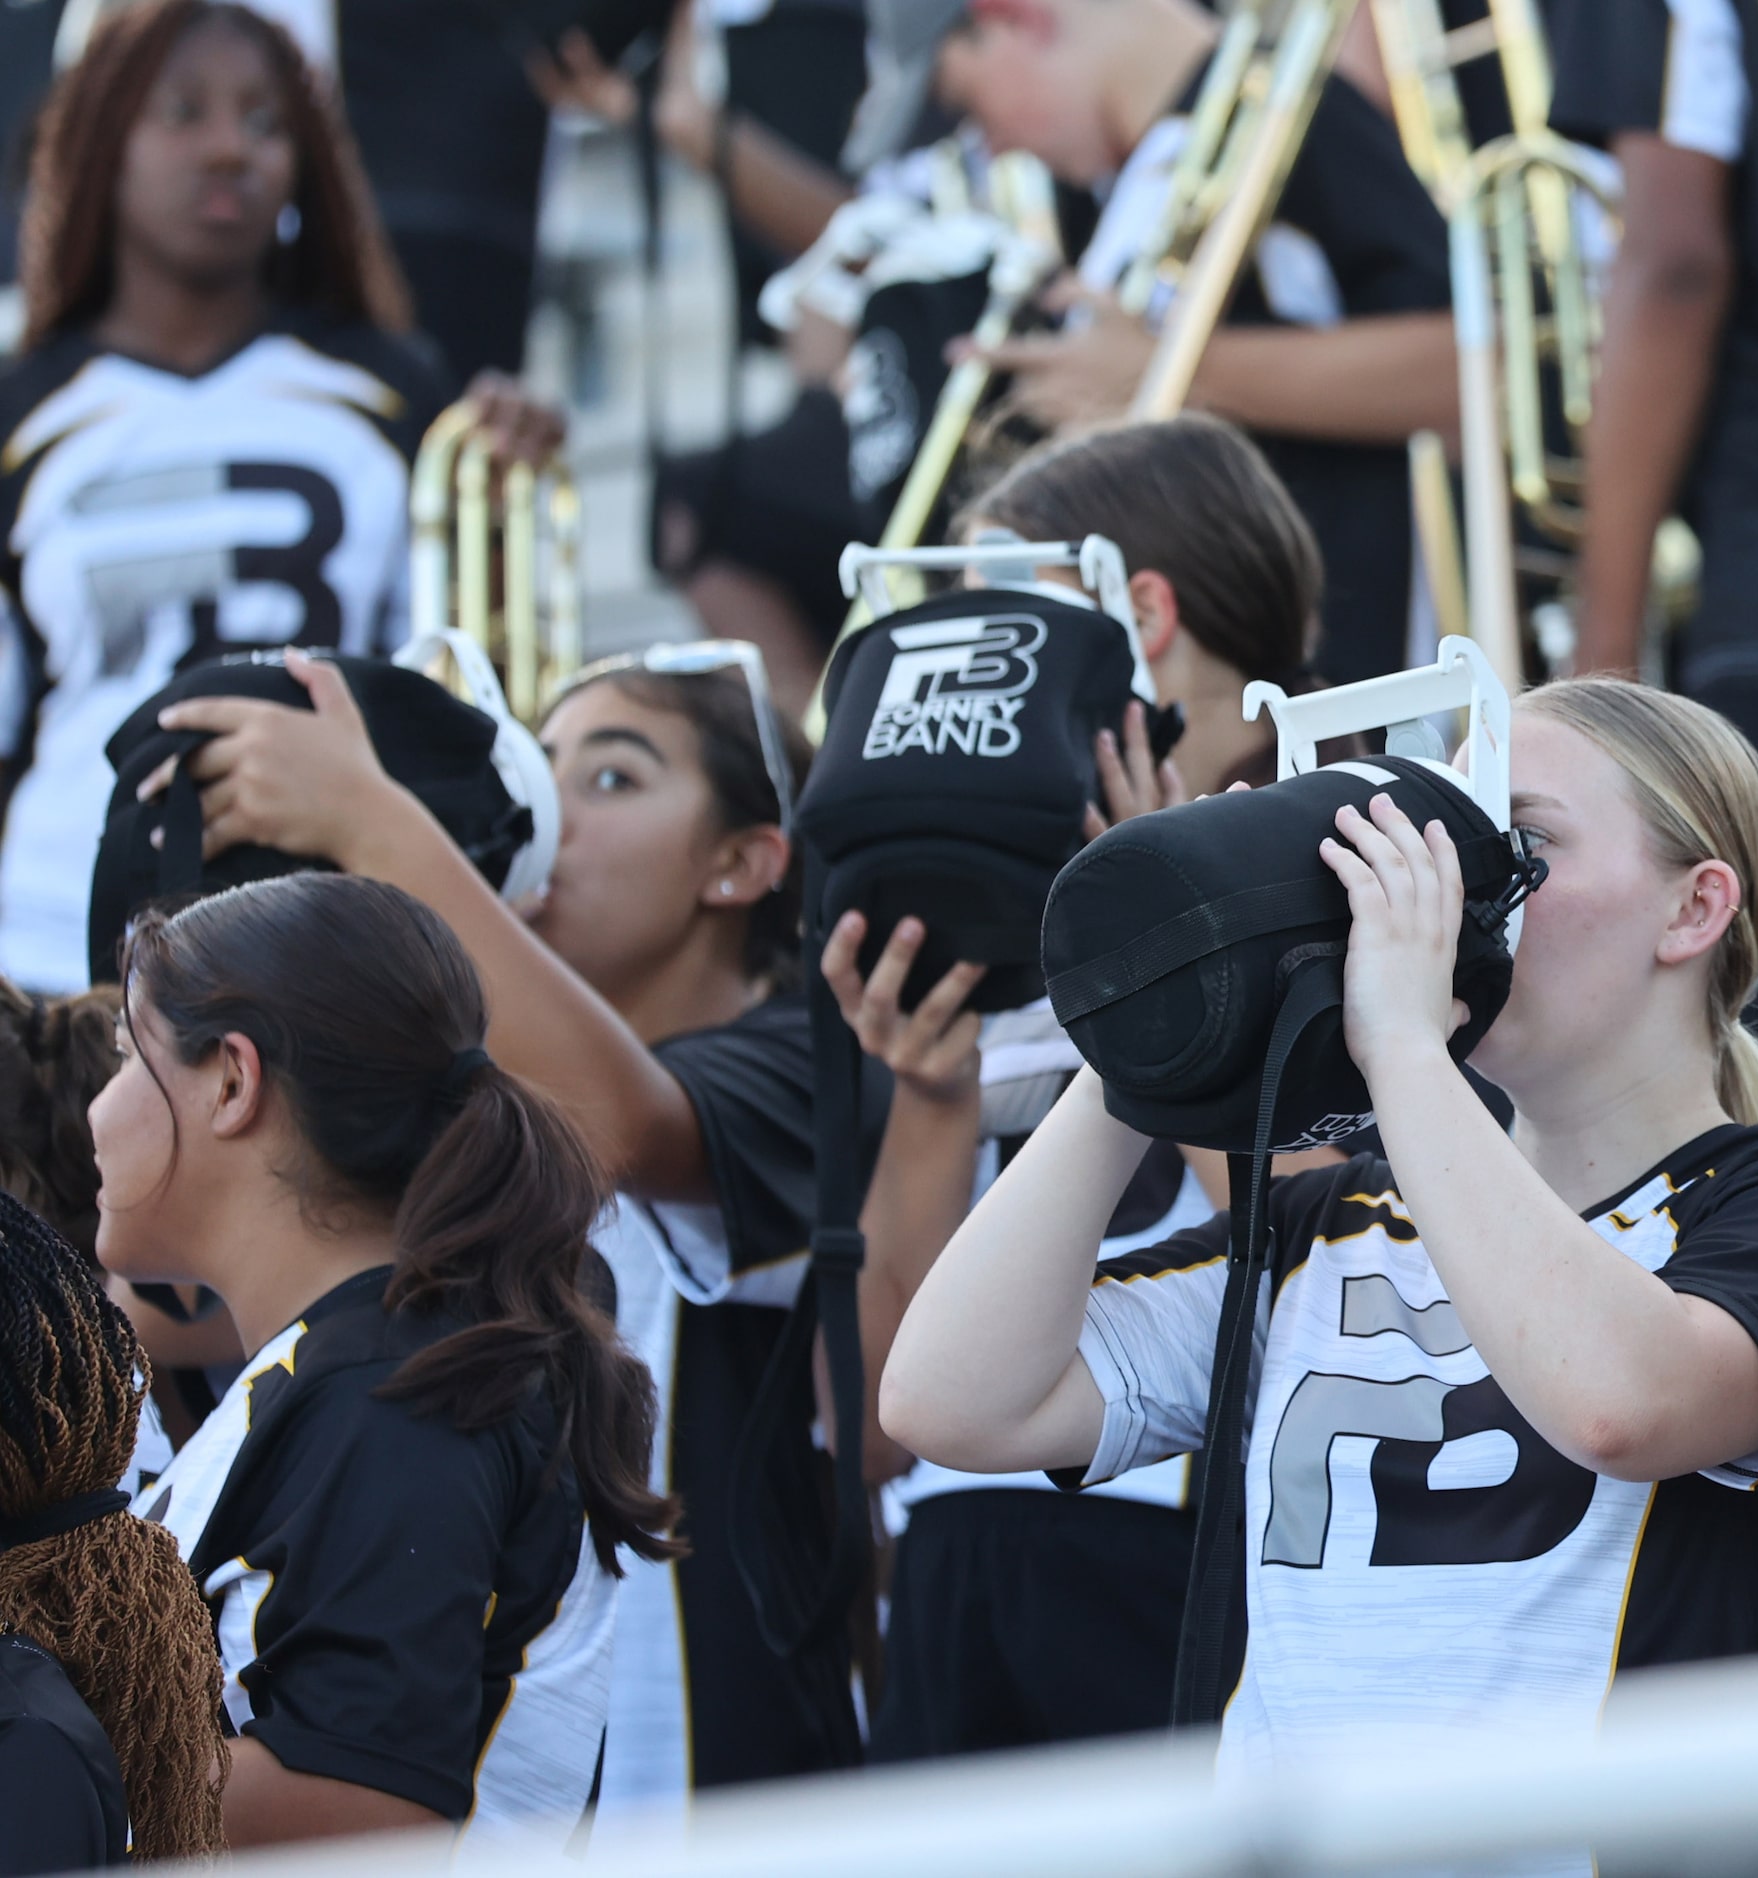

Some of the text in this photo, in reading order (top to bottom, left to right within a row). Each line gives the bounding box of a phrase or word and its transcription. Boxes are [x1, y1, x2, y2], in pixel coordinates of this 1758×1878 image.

[70, 460, 345, 680] FB
[878, 612, 1049, 704] FB
[862, 717, 1022, 760] BAND
[872, 697, 1026, 727] FORNEY
